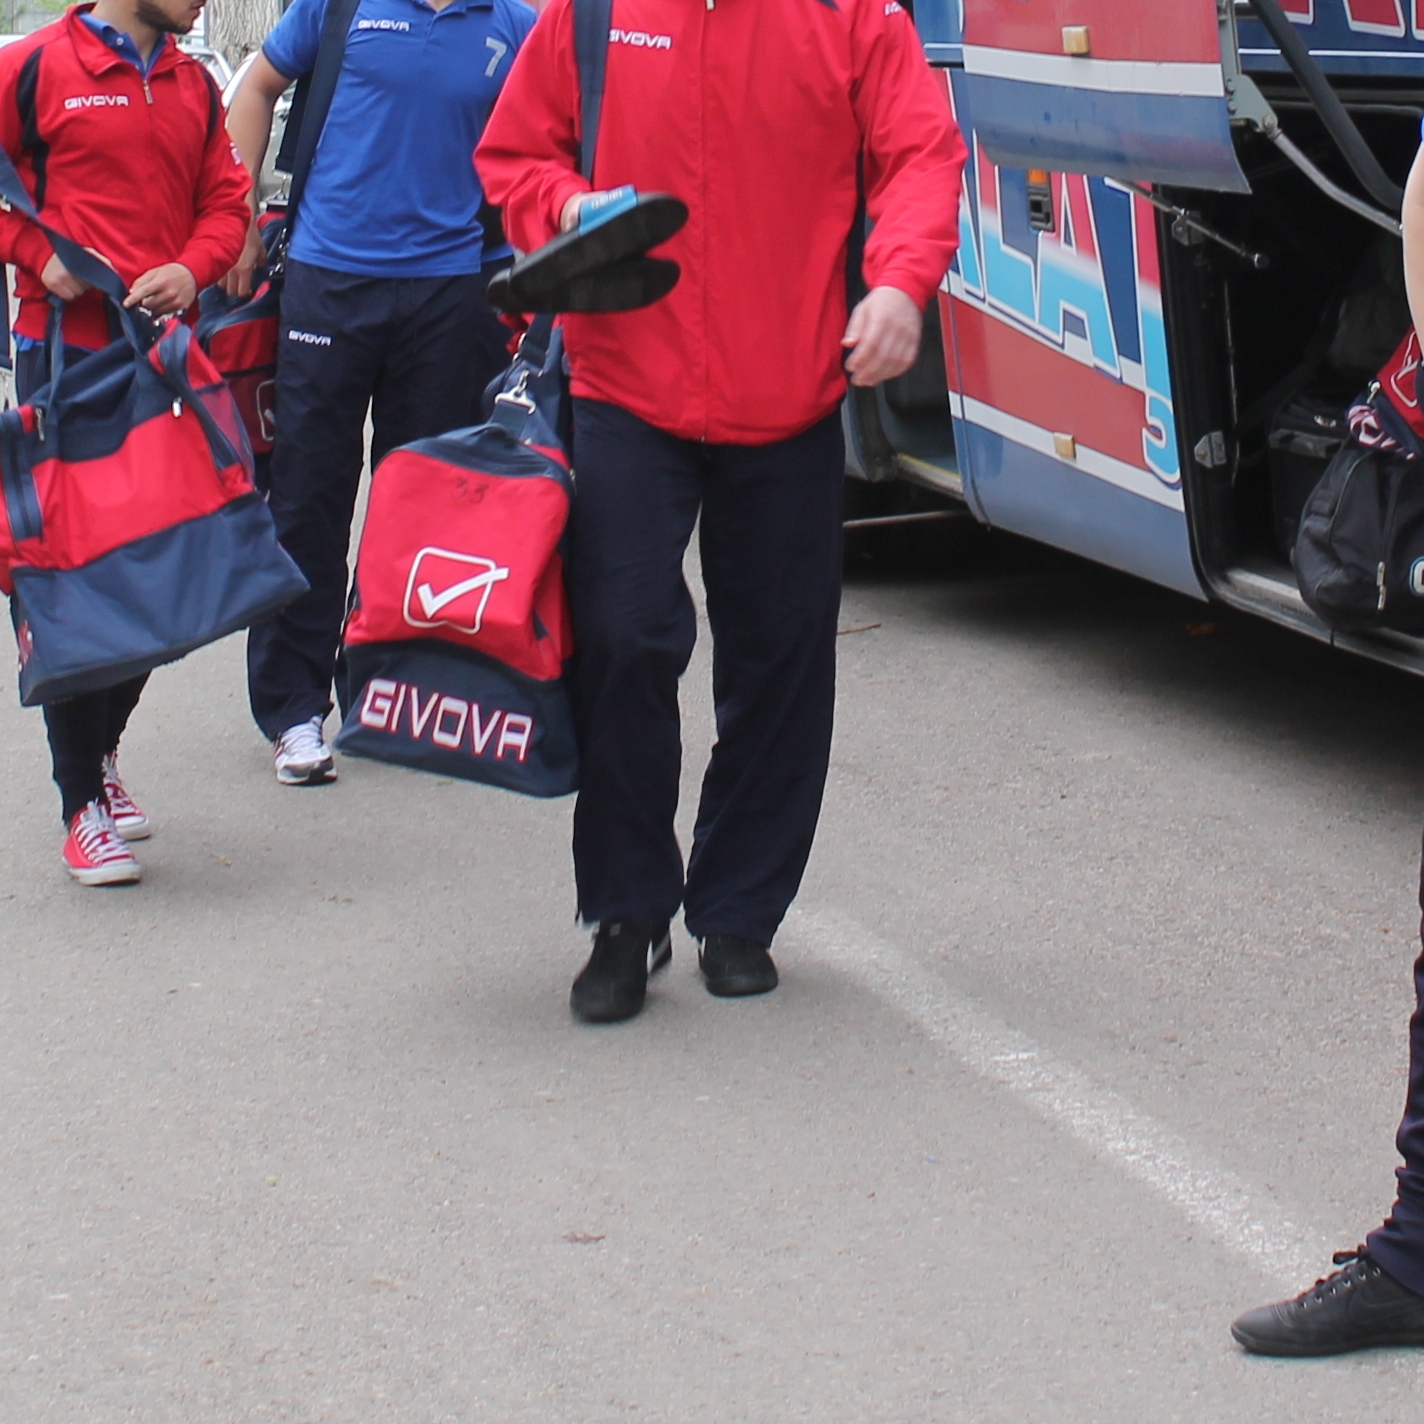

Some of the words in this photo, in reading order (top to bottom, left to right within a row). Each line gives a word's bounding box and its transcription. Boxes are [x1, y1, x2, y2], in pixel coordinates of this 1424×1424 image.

[357, 19, 411, 32] GIVOVA
[484, 35, 508, 78] 7
[63, 94, 130, 111] GIVOVA
[361, 677, 534, 763] GIVOVA
